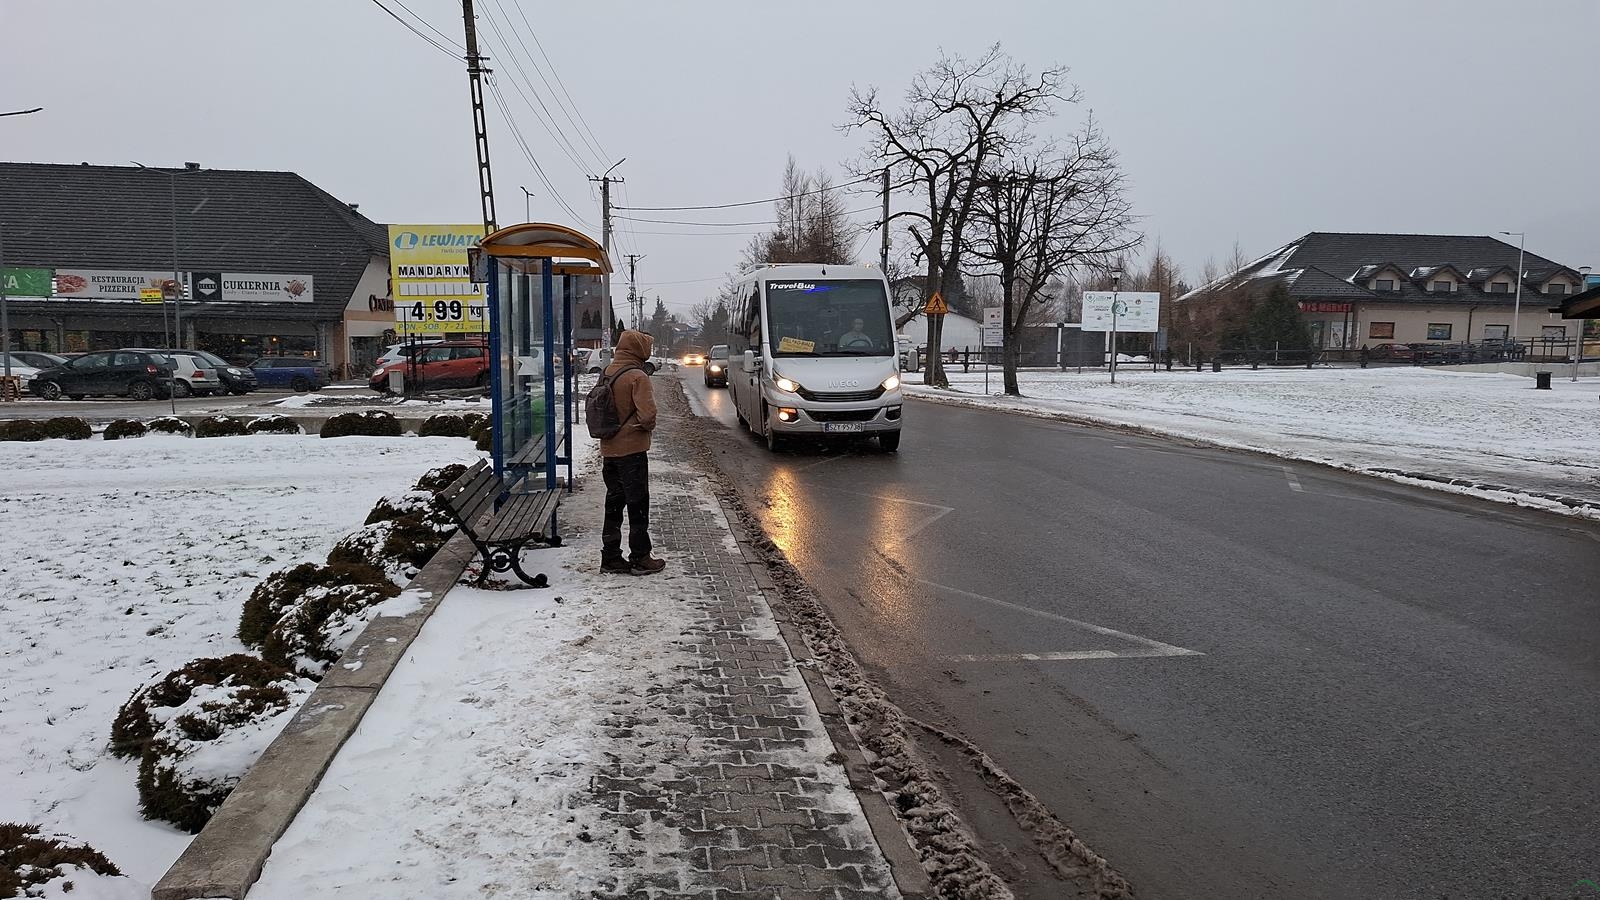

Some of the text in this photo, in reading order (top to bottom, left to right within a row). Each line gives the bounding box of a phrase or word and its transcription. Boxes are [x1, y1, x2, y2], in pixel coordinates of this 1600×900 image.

[399, 266, 469, 276] MANDARYN
[91, 275, 145, 284] RESTAURACJA
[99, 285, 136, 293] PIZZERIA
[223, 280, 281, 290] CUKIERNIA
[473, 284, 480, 293] A
[411, 300, 462, 321] 4,99
[470, 305, 482, 317] kg
[828, 380, 859, 388] IVECO
